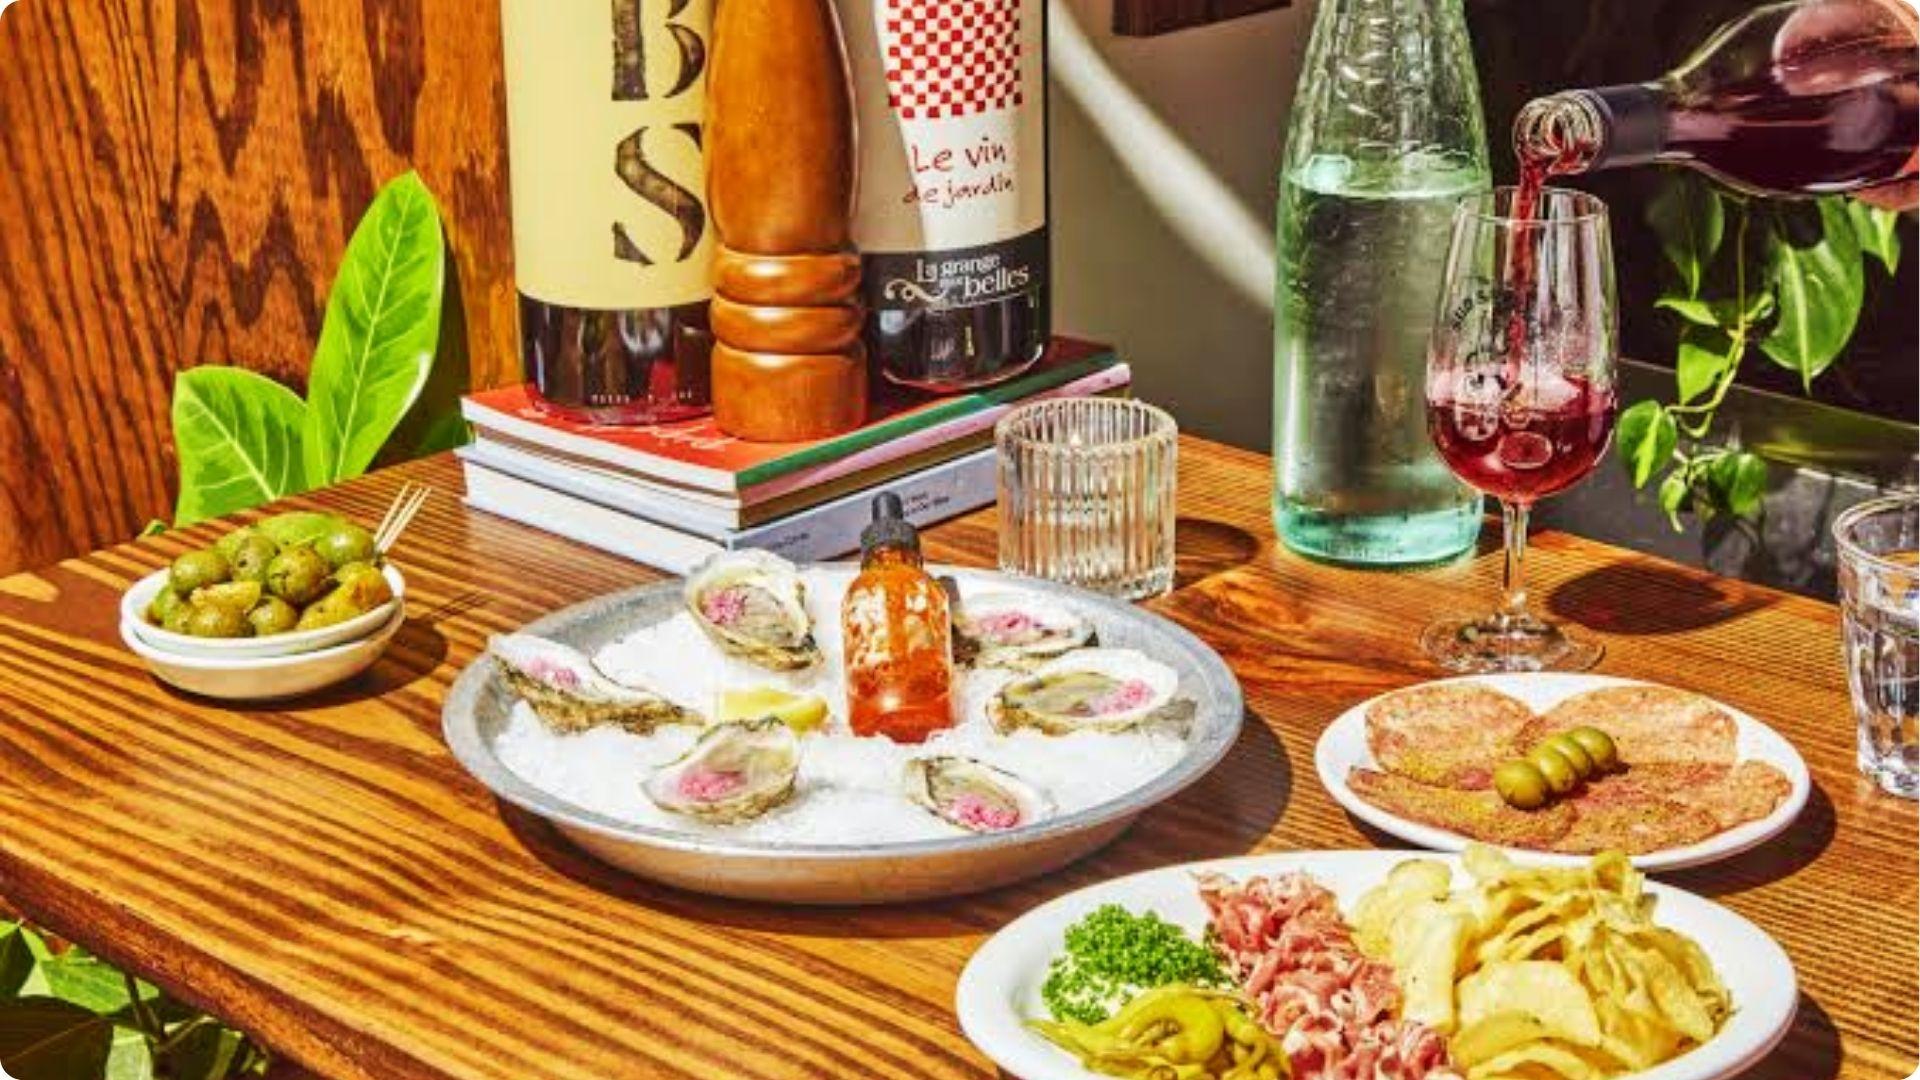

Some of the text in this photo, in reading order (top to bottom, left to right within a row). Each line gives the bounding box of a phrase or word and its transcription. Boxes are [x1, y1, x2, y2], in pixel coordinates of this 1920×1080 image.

[911, 136, 1007, 173] Le vin
[902, 173, 1015, 209] de jardin
[940, 253, 1000, 278] grange
[964, 264, 1029, 298] belles
